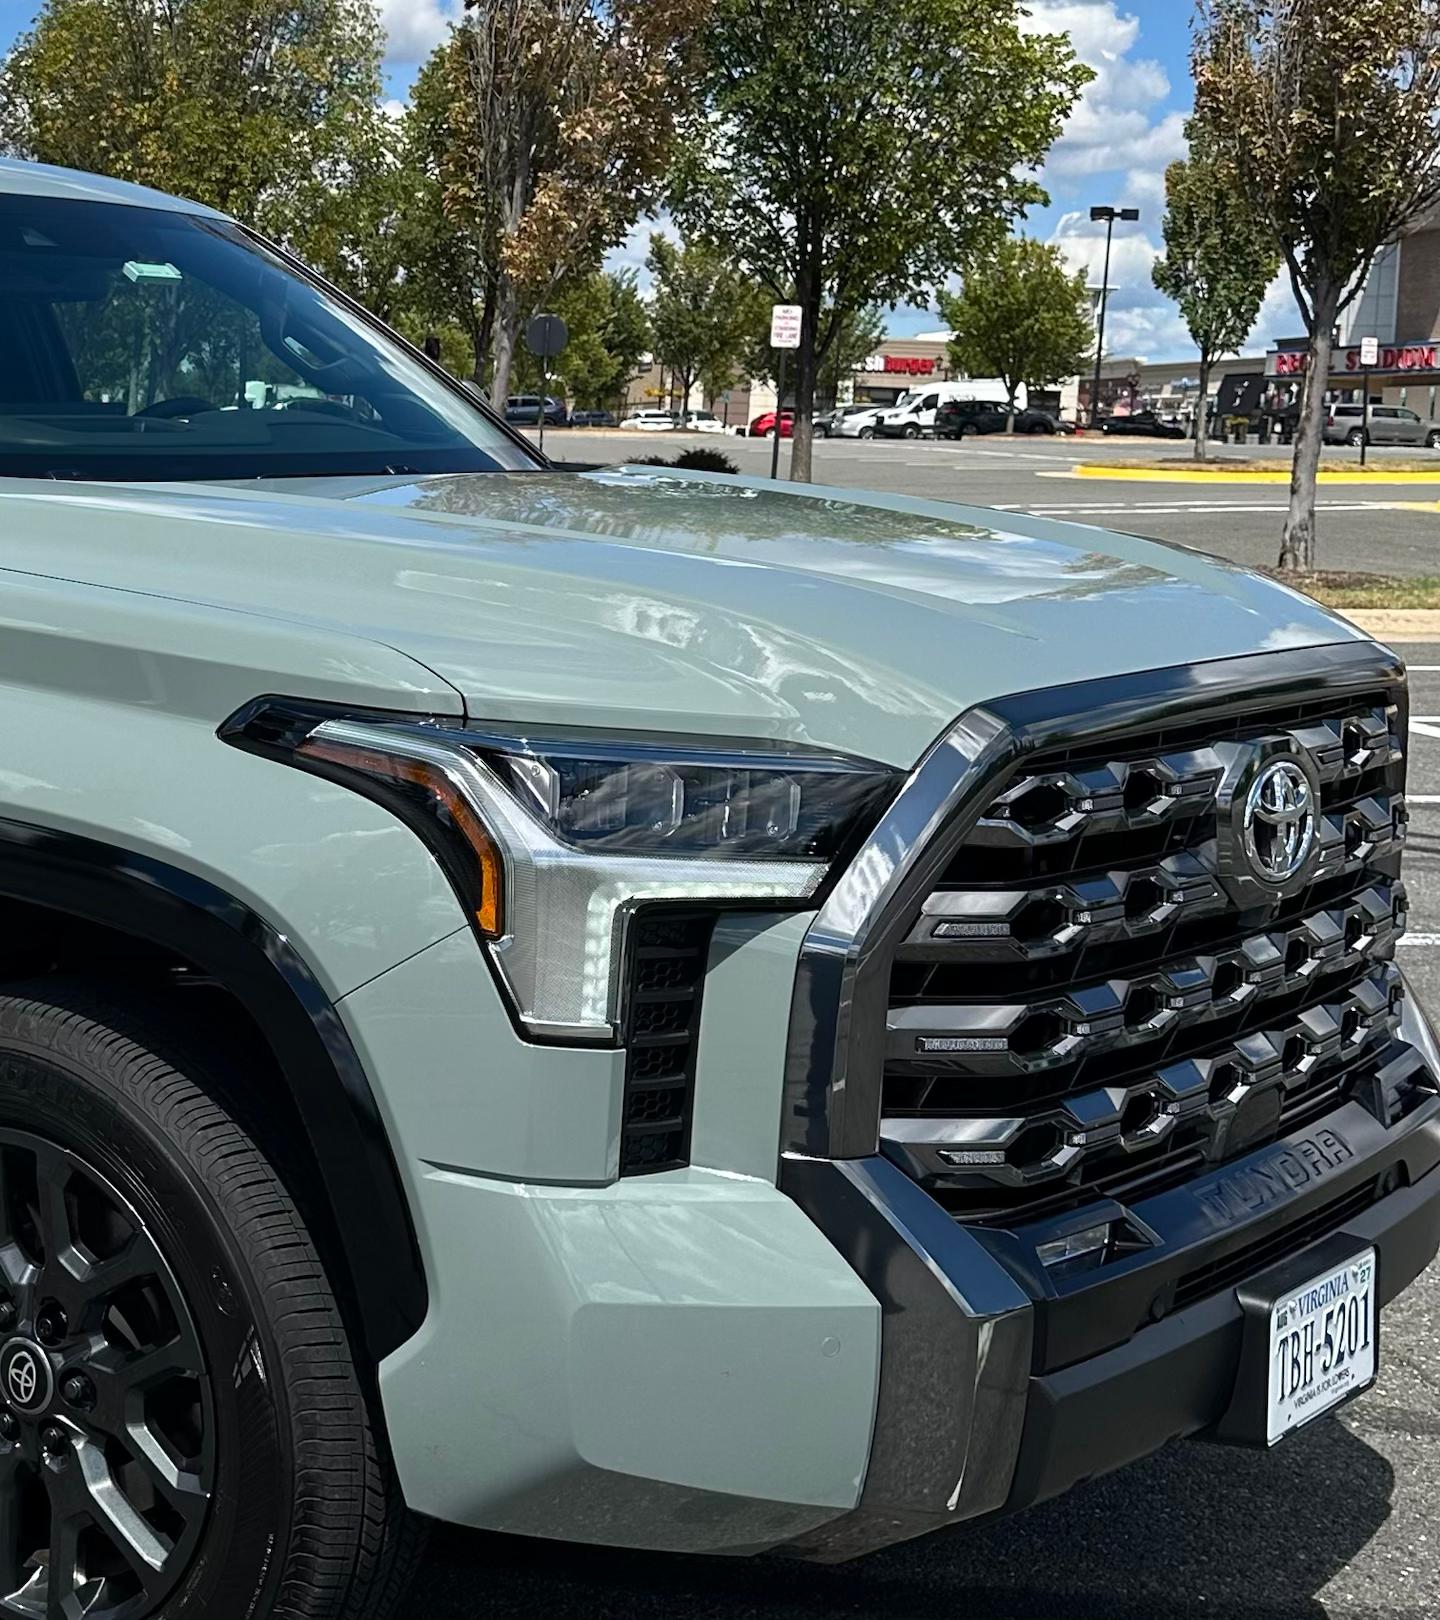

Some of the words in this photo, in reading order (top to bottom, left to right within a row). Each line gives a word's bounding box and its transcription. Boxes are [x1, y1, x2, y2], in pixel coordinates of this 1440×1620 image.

[1346, 346, 1437, 371] SDIUM
[1193, 1129, 1354, 1223] TUNDRA
[1298, 1271, 1349, 1317] VIRGINIA
[1360, 1266, 1371, 1283] 27
[1277, 1288, 1370, 1402] TBH-5201
